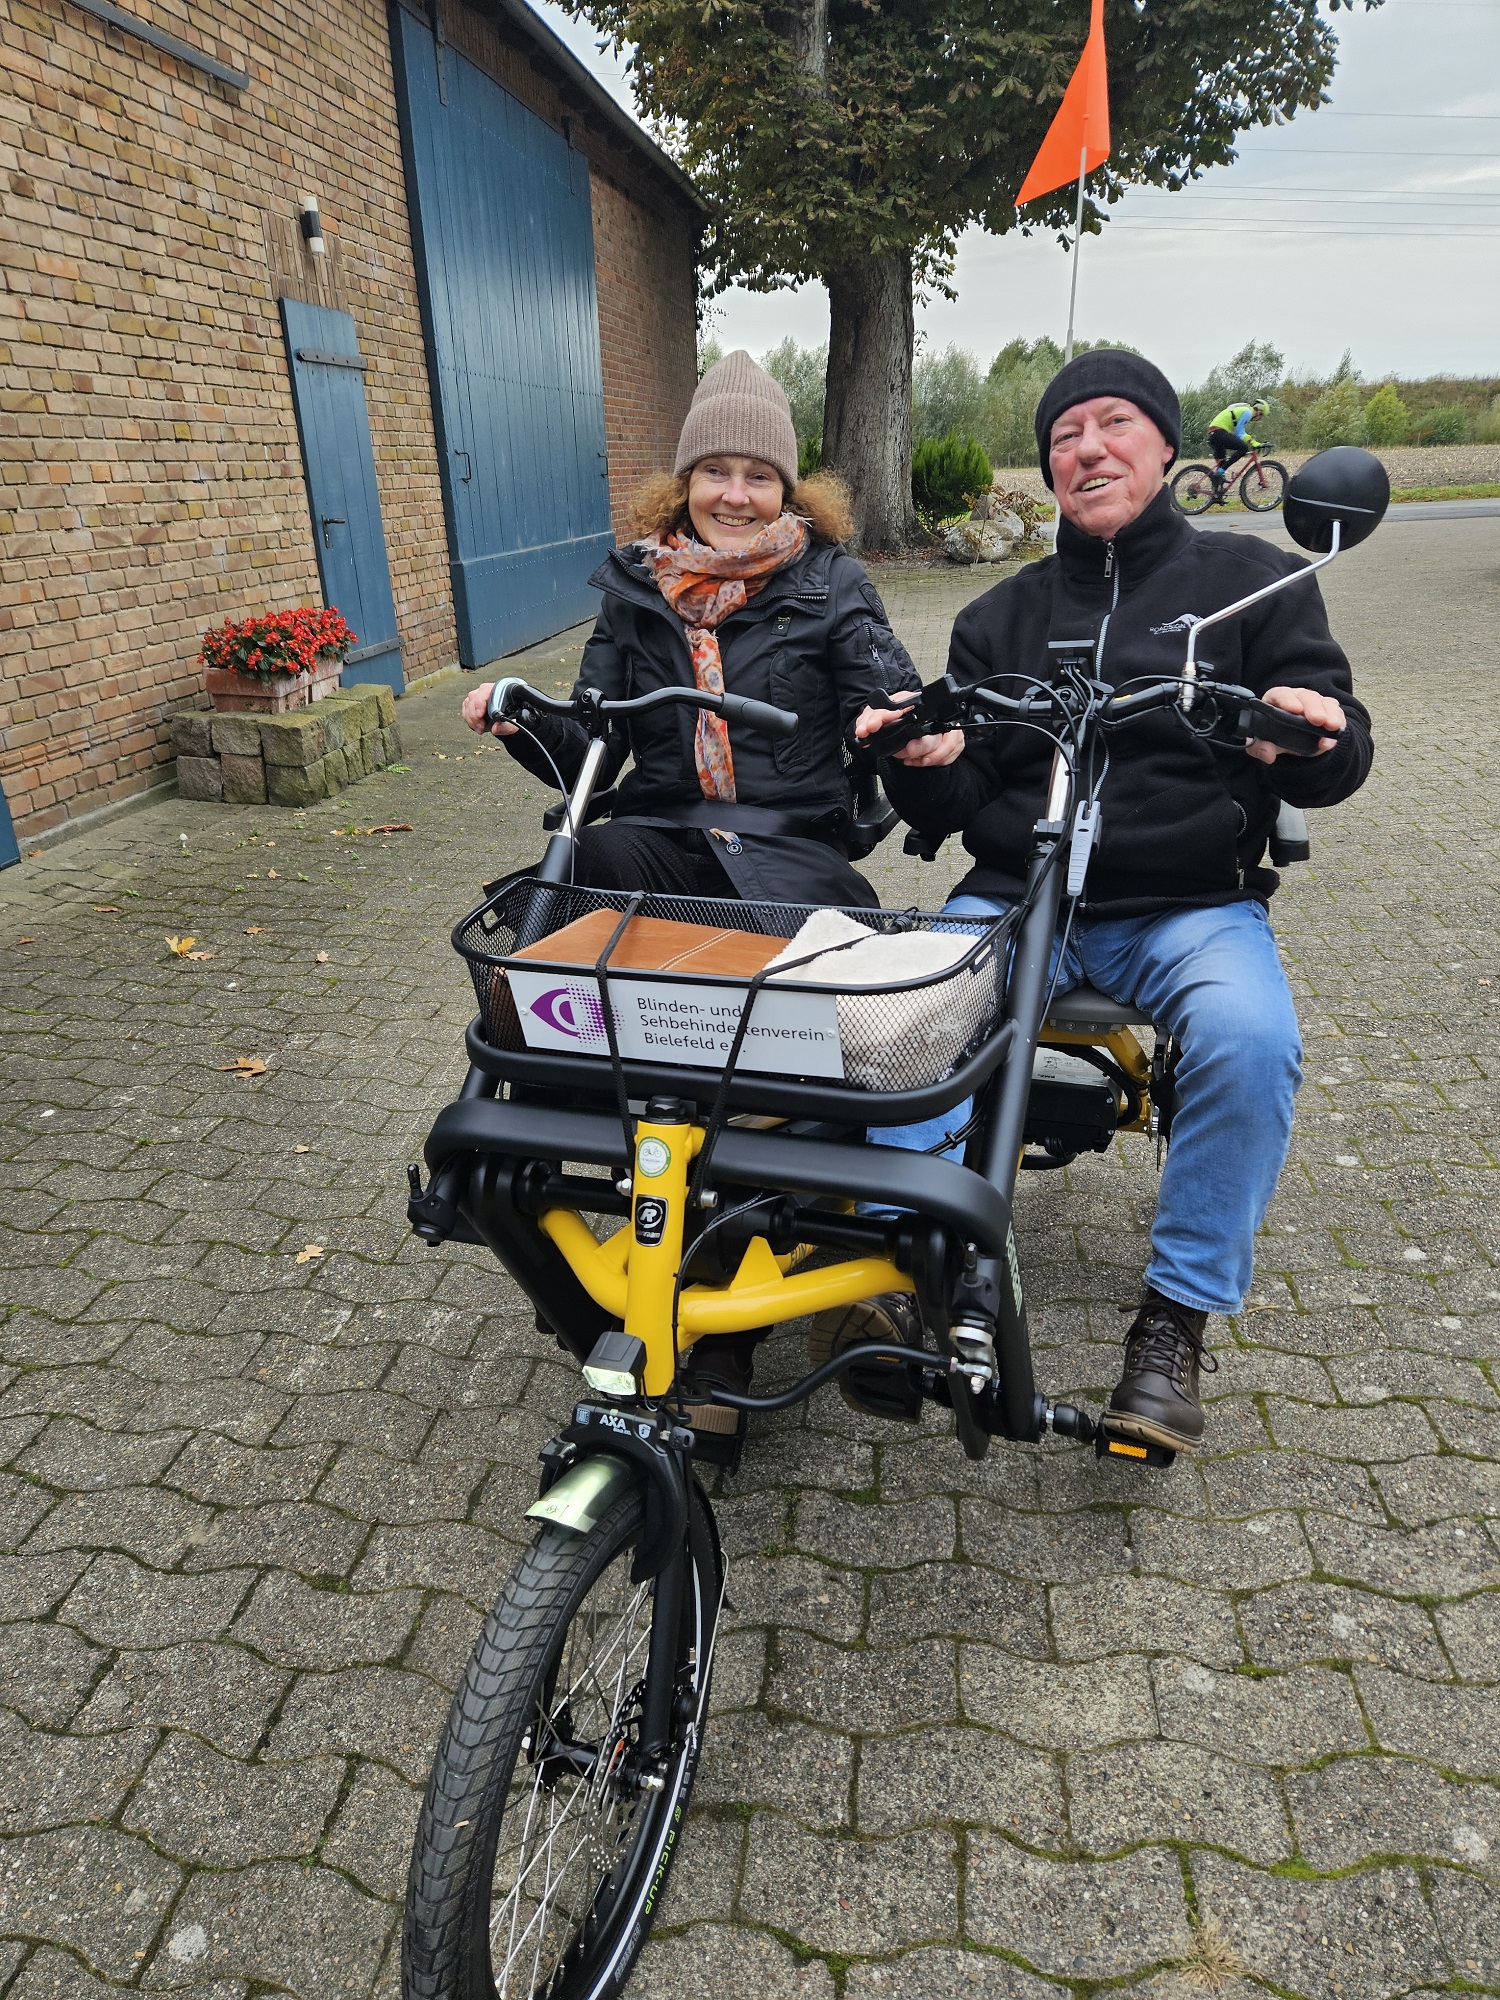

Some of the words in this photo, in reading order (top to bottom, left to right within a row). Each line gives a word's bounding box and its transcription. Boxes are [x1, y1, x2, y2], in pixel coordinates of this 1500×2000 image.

[637, 997, 705, 1014] Blinden-
[710, 1005, 742, 1018] und
[641, 1014, 825, 1042] Sehbehindetenverein
[644, 1032, 715, 1050] Bielefeld
[599, 1414, 627, 1431] AXA
[645, 1829, 676, 1915] PICK-UP
